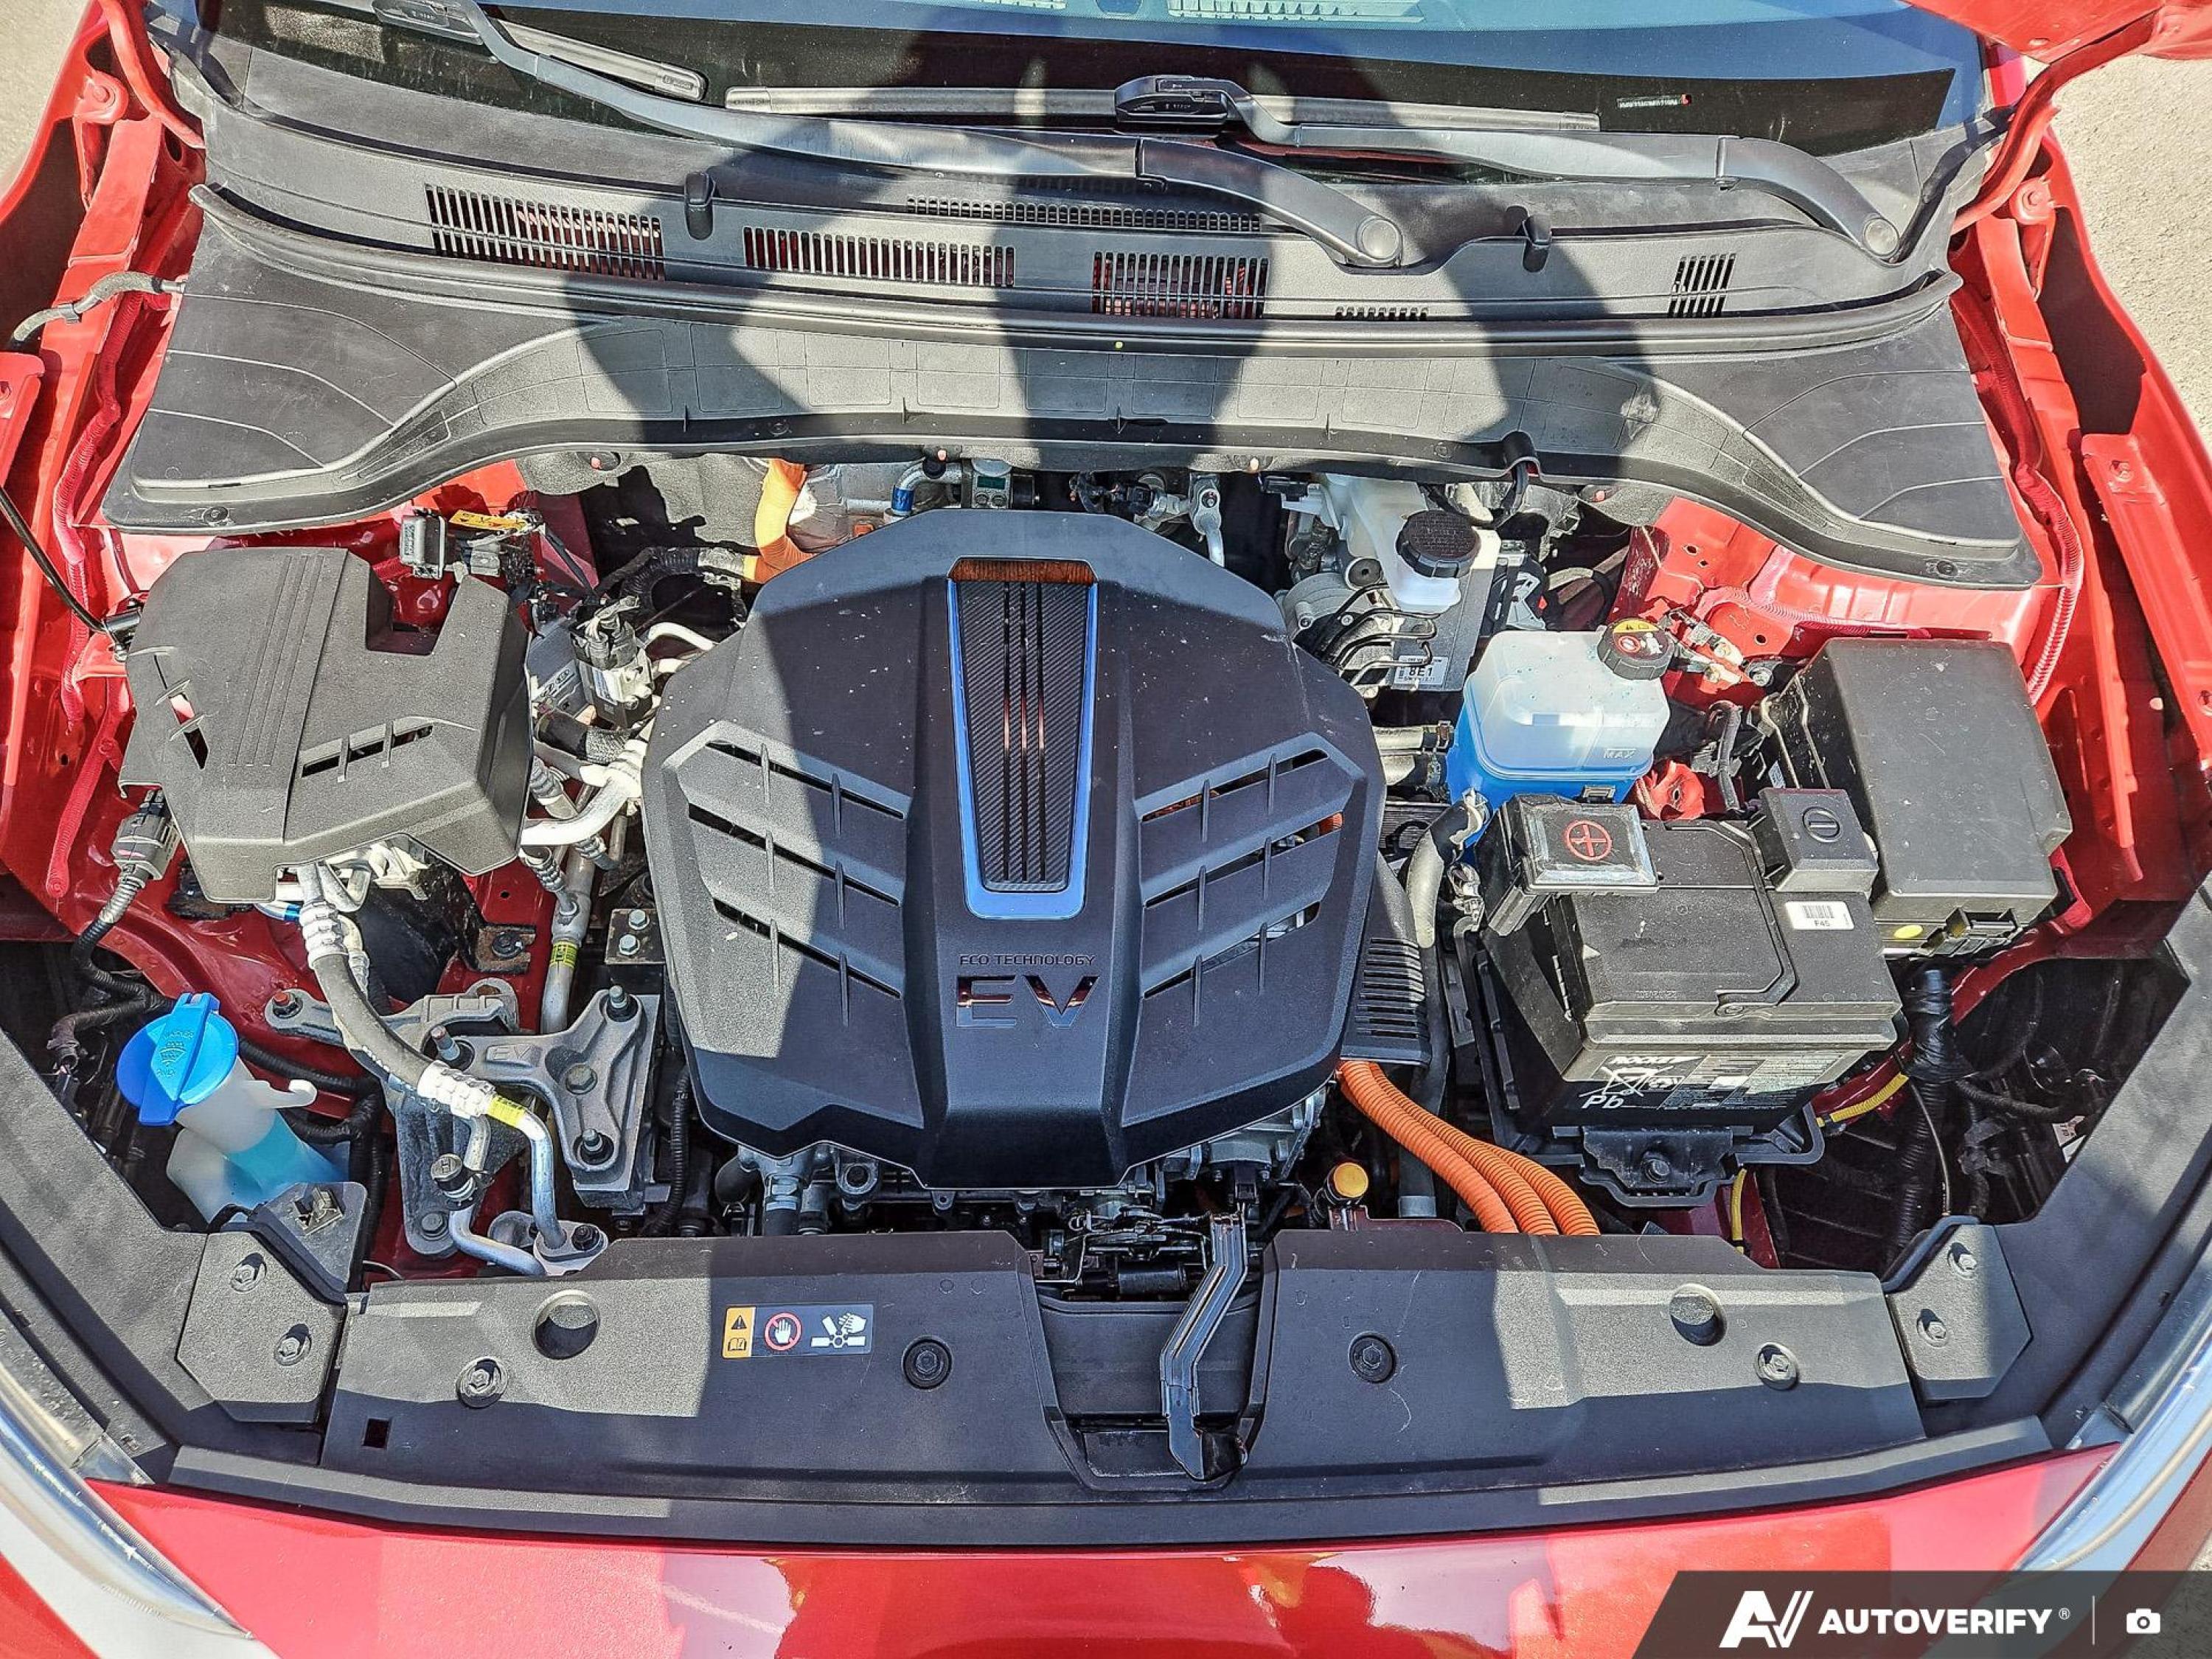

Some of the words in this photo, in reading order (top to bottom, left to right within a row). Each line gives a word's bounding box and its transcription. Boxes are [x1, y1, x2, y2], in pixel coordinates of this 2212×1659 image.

[960, 954, 989, 966] ECO
[995, 954, 1095, 966] TECHNOLOGY
[956, 975, 1100, 1028] EV
[1581, 1095, 1624, 1109] Pb
